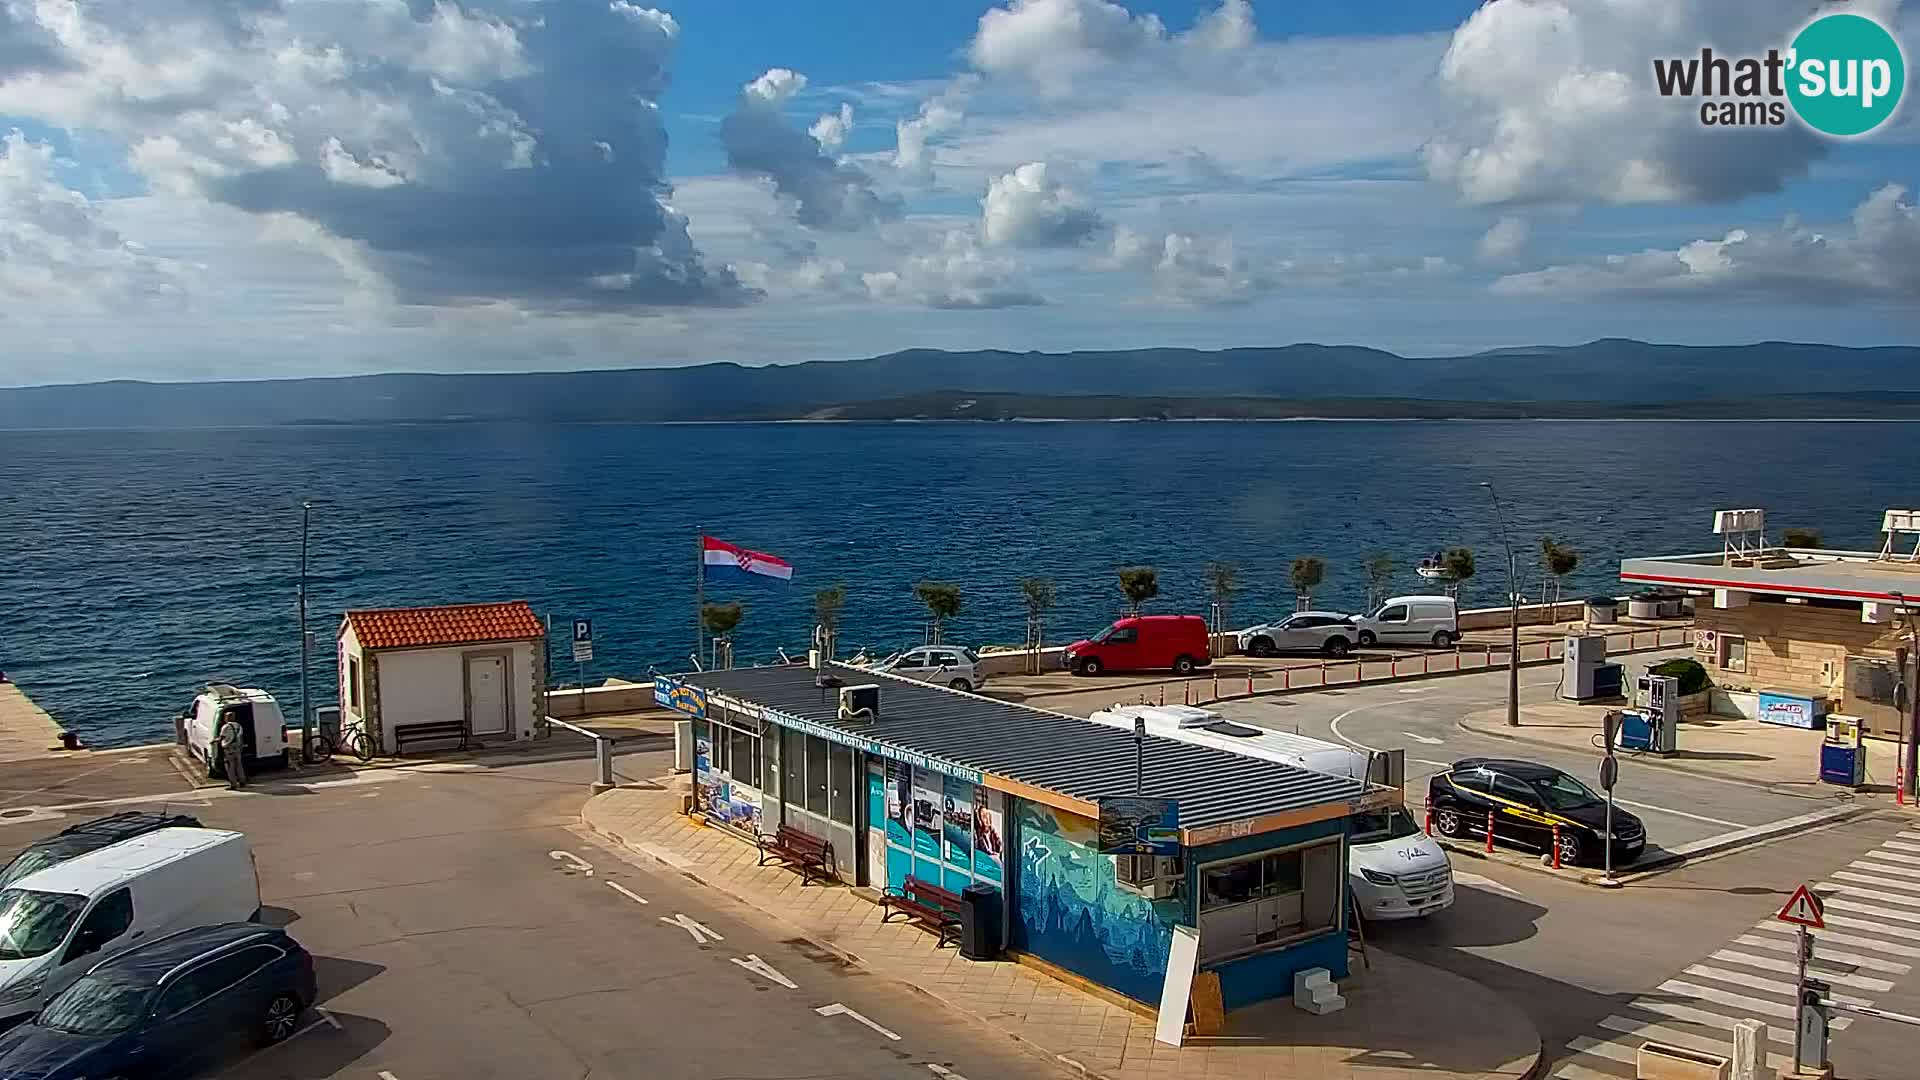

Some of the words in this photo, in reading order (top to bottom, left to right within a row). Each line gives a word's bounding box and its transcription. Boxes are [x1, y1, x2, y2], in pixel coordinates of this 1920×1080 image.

[577, 622, 588, 639] P
[805, 723, 842, 742] AUTOBUSNA
[842, 734, 871, 751] POSTAJA
[880, 745, 895, 757] BUS
[895, 750, 926, 768] STATION
[928, 759, 952, 775] TICKET
[953, 766, 979, 782] OFFICE
